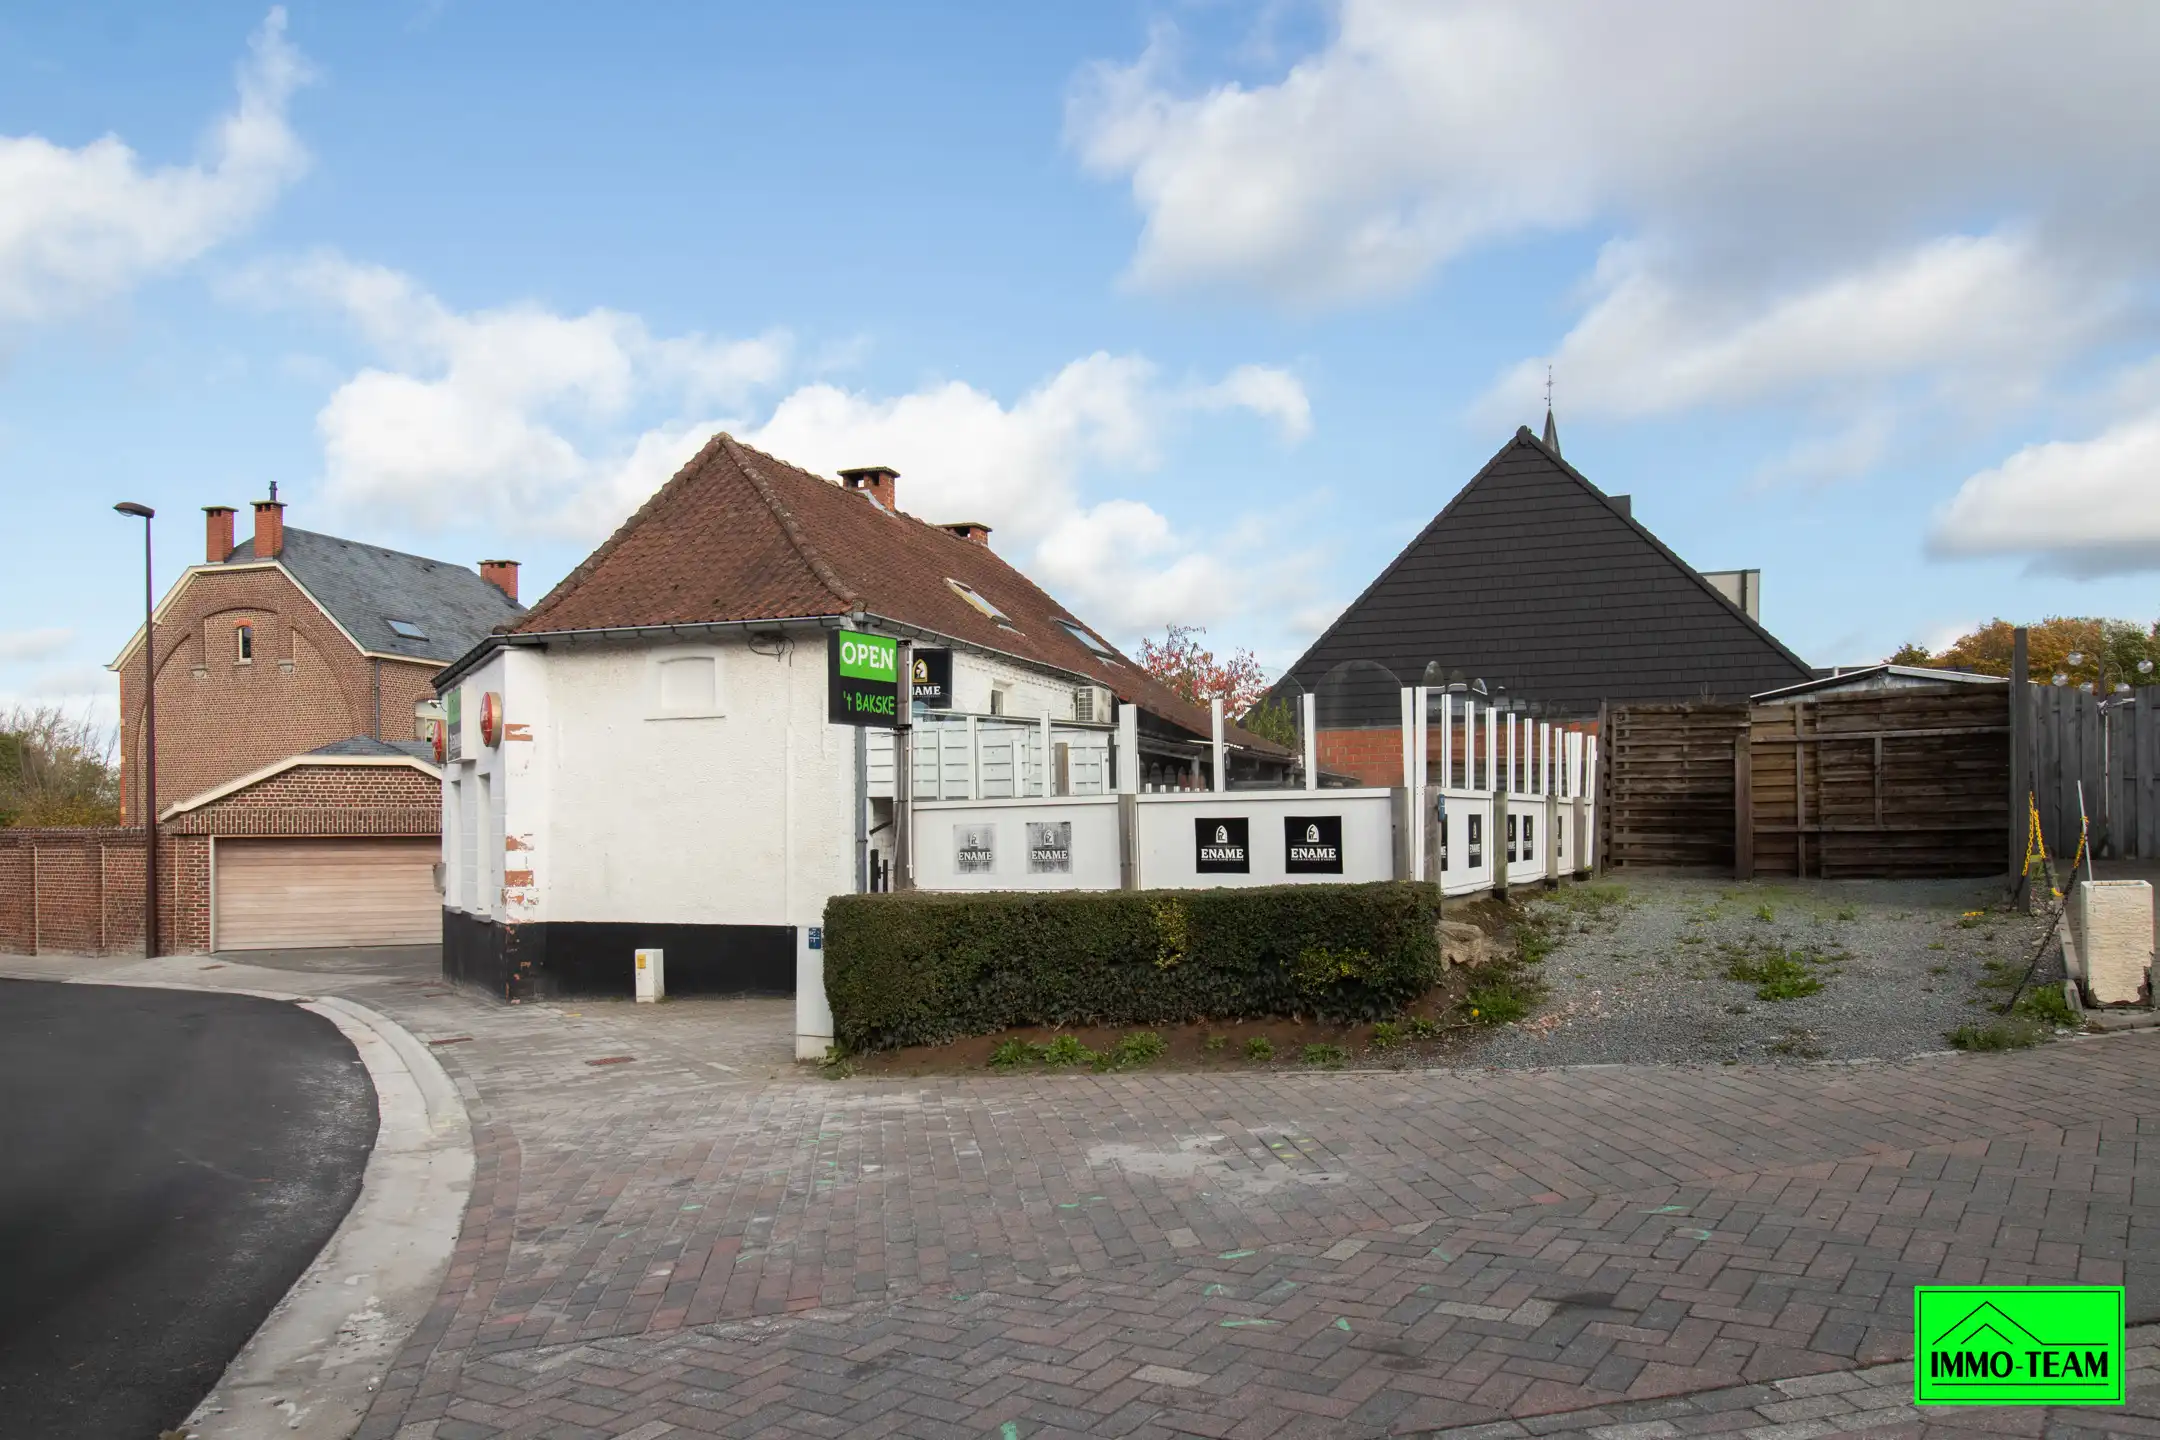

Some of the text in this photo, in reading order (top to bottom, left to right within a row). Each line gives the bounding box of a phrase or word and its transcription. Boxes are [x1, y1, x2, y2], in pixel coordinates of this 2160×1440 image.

[841, 641, 894, 671] OPEN
[855, 691, 895, 716] BAKSKE
[958, 851, 993, 861] ENAME
[1030, 850, 1069, 860] ENAME
[1200, 848, 1244, 859] ENAME
[1290, 847, 1337, 859] ENAME
